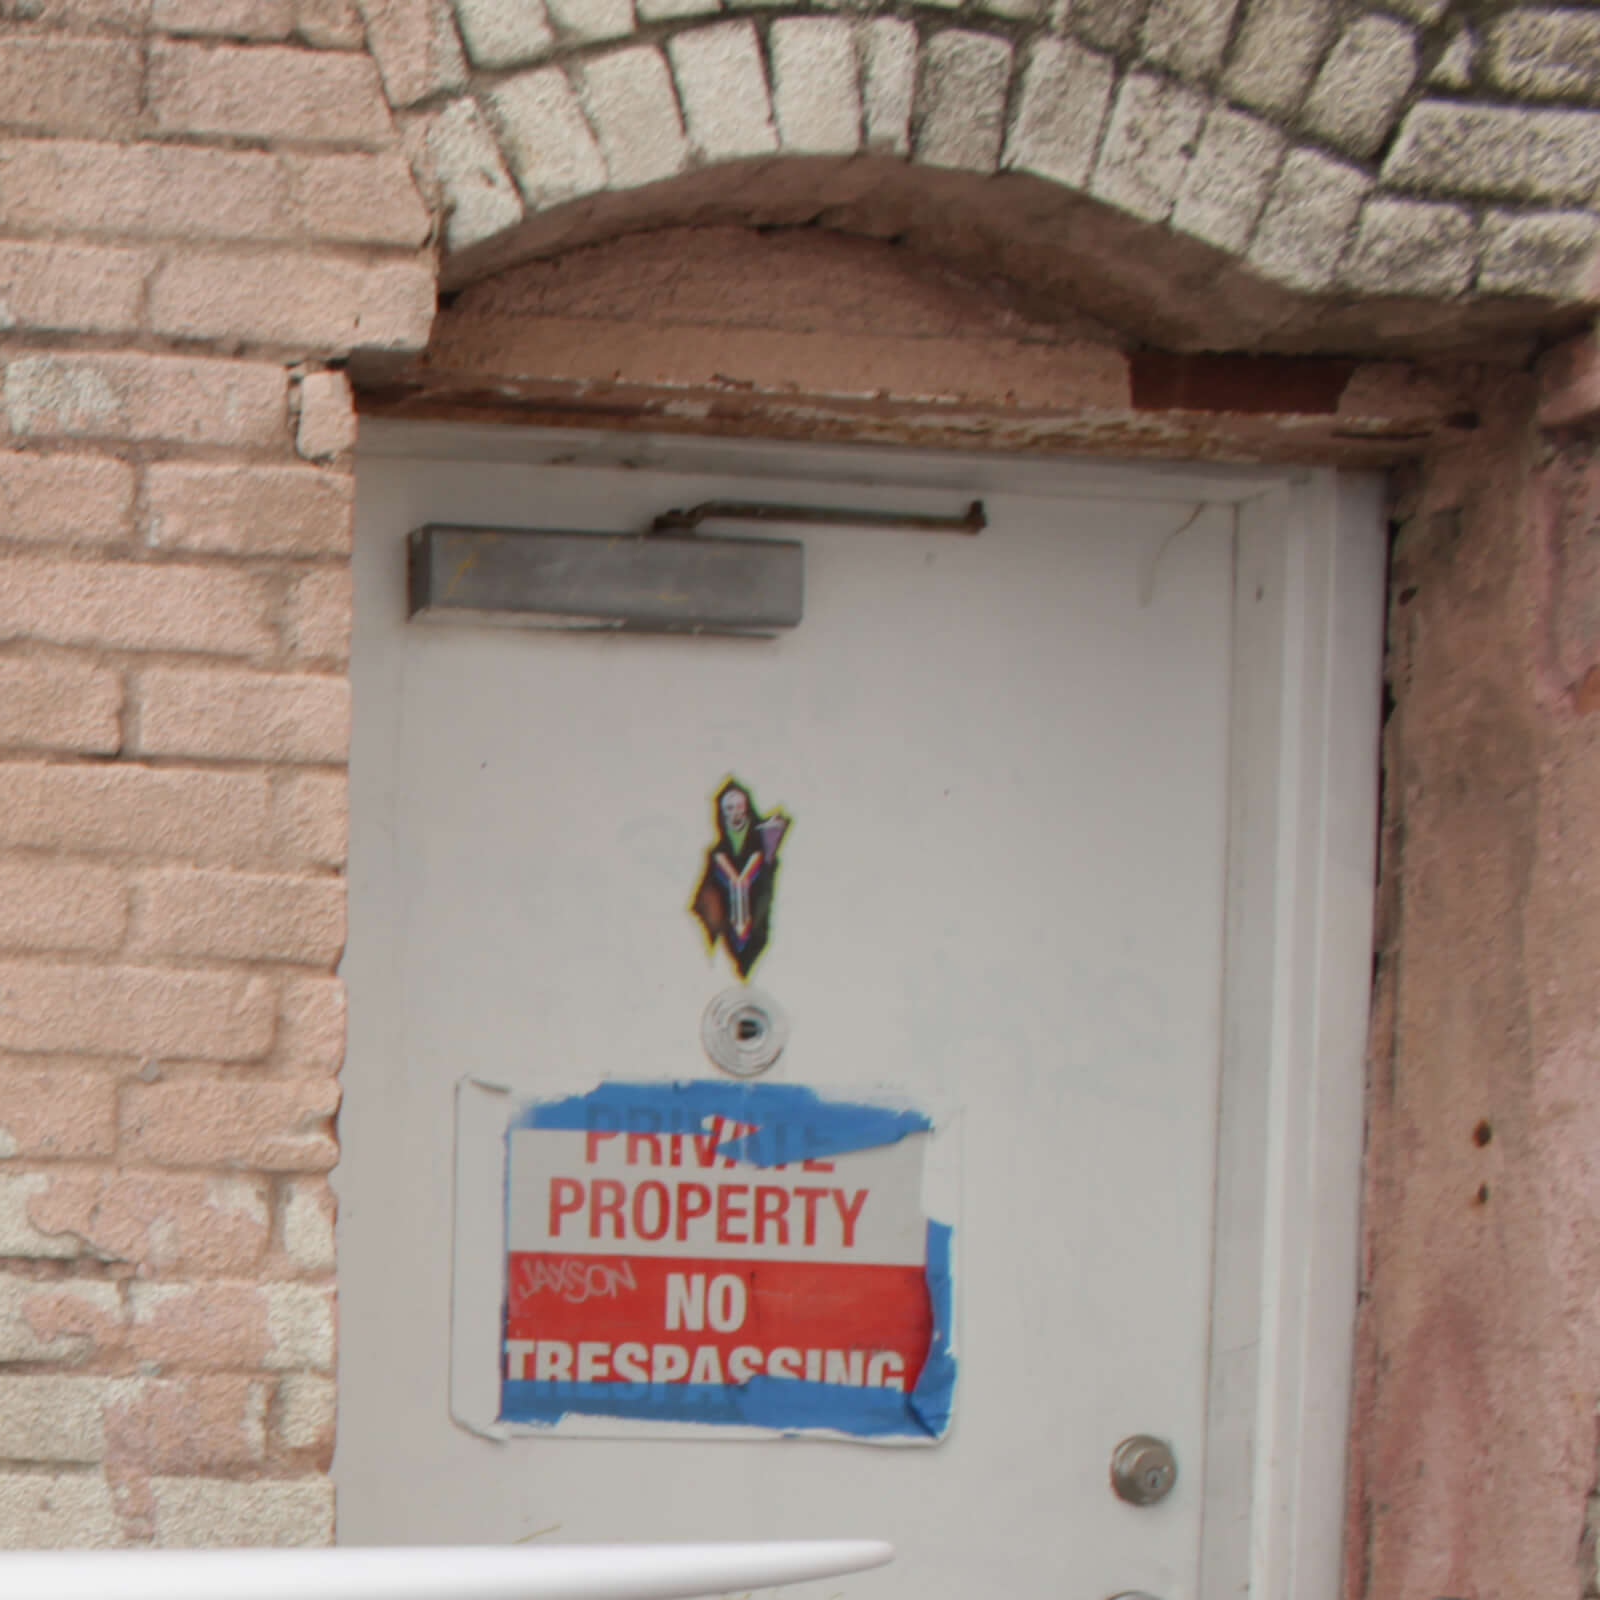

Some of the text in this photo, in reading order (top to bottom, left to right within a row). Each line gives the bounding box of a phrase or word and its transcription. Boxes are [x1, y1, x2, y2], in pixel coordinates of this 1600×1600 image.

[548, 1177, 869, 1248] PROPERTY
[517, 1258, 638, 1304] JAXSON
[664, 1272, 747, 1333] NO
